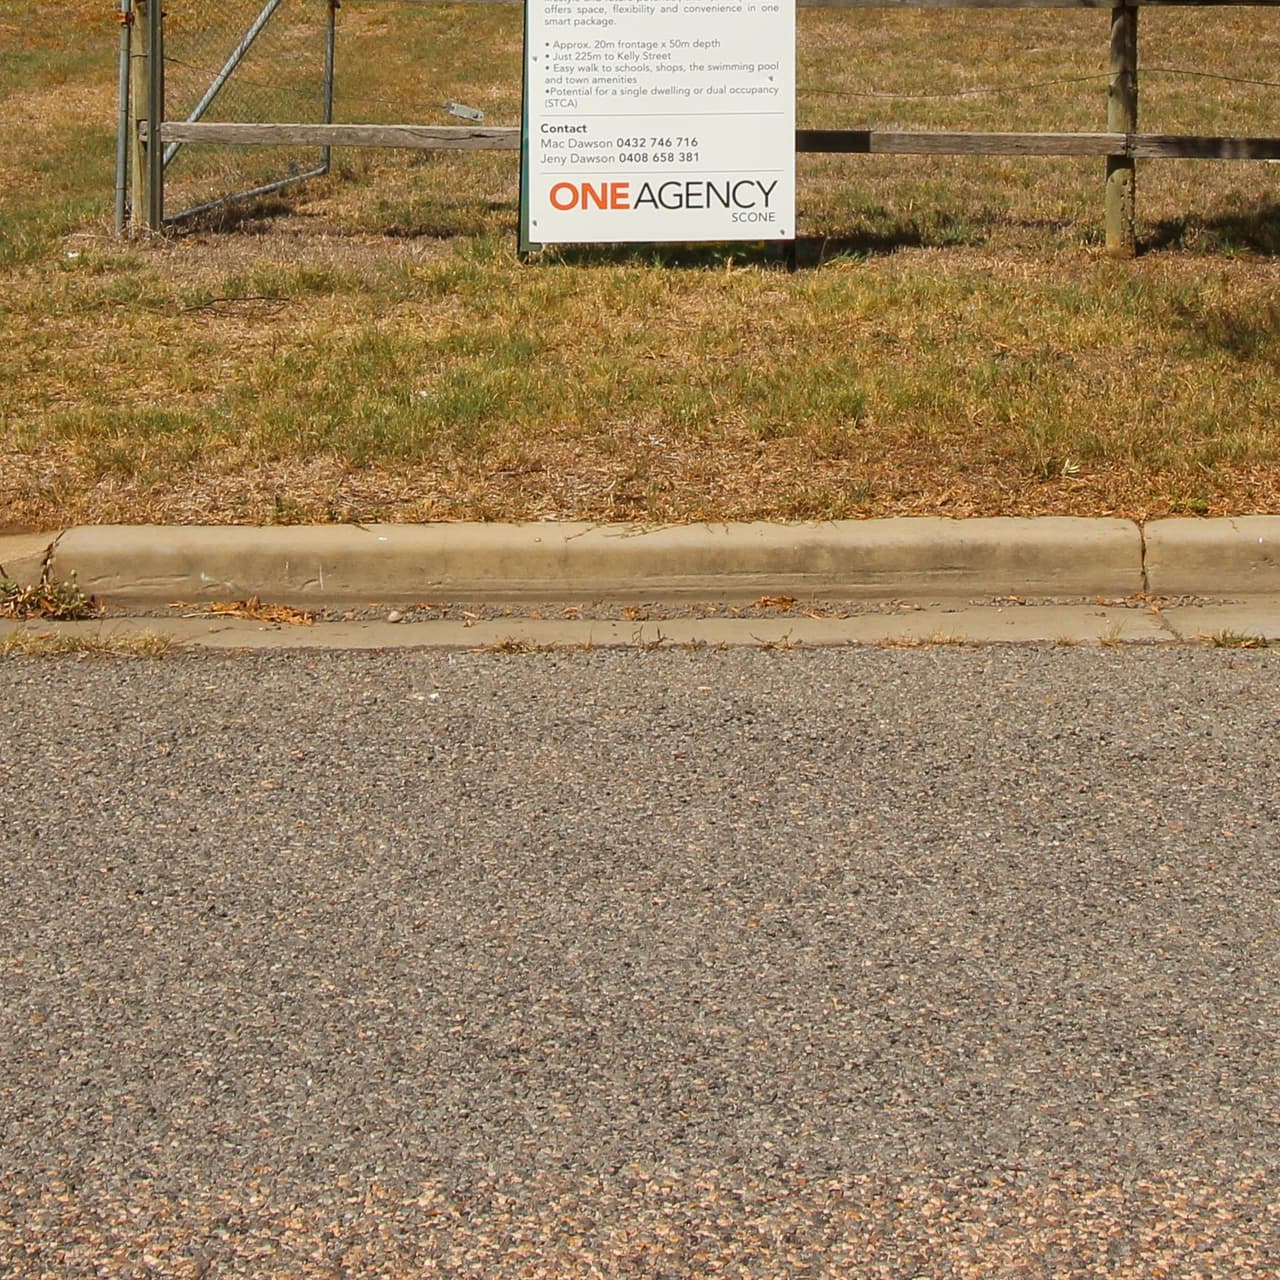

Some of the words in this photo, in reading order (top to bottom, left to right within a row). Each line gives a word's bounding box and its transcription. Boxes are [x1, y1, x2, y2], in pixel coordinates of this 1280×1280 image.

[545, 5, 571, 14] offers
[577, 6, 607, 16] space,
[613, 4, 655, 15] flexibility
[660, 4, 678, 13] and
[683, 4, 742, 13] convenience
[748, 4, 755, 12] in
[761, 4, 779, 12] one
[545, 18, 571, 26] smart
[574, 17, 616, 27] package.
[553, 40, 590, 51] Approx.
[594, 40, 615, 49] 20m
[618, 40, 658, 51] frontage
[670, 39, 689, 48] 50m
[693, 39, 720, 50] depth
[553, 52, 572, 61] Just
[575, 52, 601, 61] 225m
[604, 52, 614, 60] to
[618, 52, 639, 62] Kelly
[643, 52, 671, 60] Street
[553, 64, 574, 75] Easy
[578, 64, 599, 72] walk
[602, 64, 612, 72] to
[615, 63, 653, 74] schools,
[656, 63, 686, 74] shops,
[689, 63, 704, 71] the
[707, 63, 754, 73] swimming
[758, 62, 779, 72] pool
[545, 76, 562, 84] and
[566, 76, 589, 84] town
[592, 75, 637, 84] amenities
[550, 87, 592, 96] Potential
[596, 87, 608, 96] for
[620, 86, 648, 97] single
[651, 86, 690, 97] dwelling
[706, 86, 726, 95] dual
[729, 86, 779, 96] occupancy
[545, 99, 578, 108] (STCA)
[540, 124, 587, 134] Contact
[541, 139, 564, 149] Mac
[568, 139, 613, 149] Dawson
[616, 138, 646, 148] 0432
[650, 137, 672, 148] 746
[676, 137, 698, 148] 716
[570, 153, 615, 164] Dawson
[619, 153, 648, 163] 0408
[653, 153, 674, 163] 658
[679, 152, 699, 163] 381
[732, 212, 776, 223] SCONE
